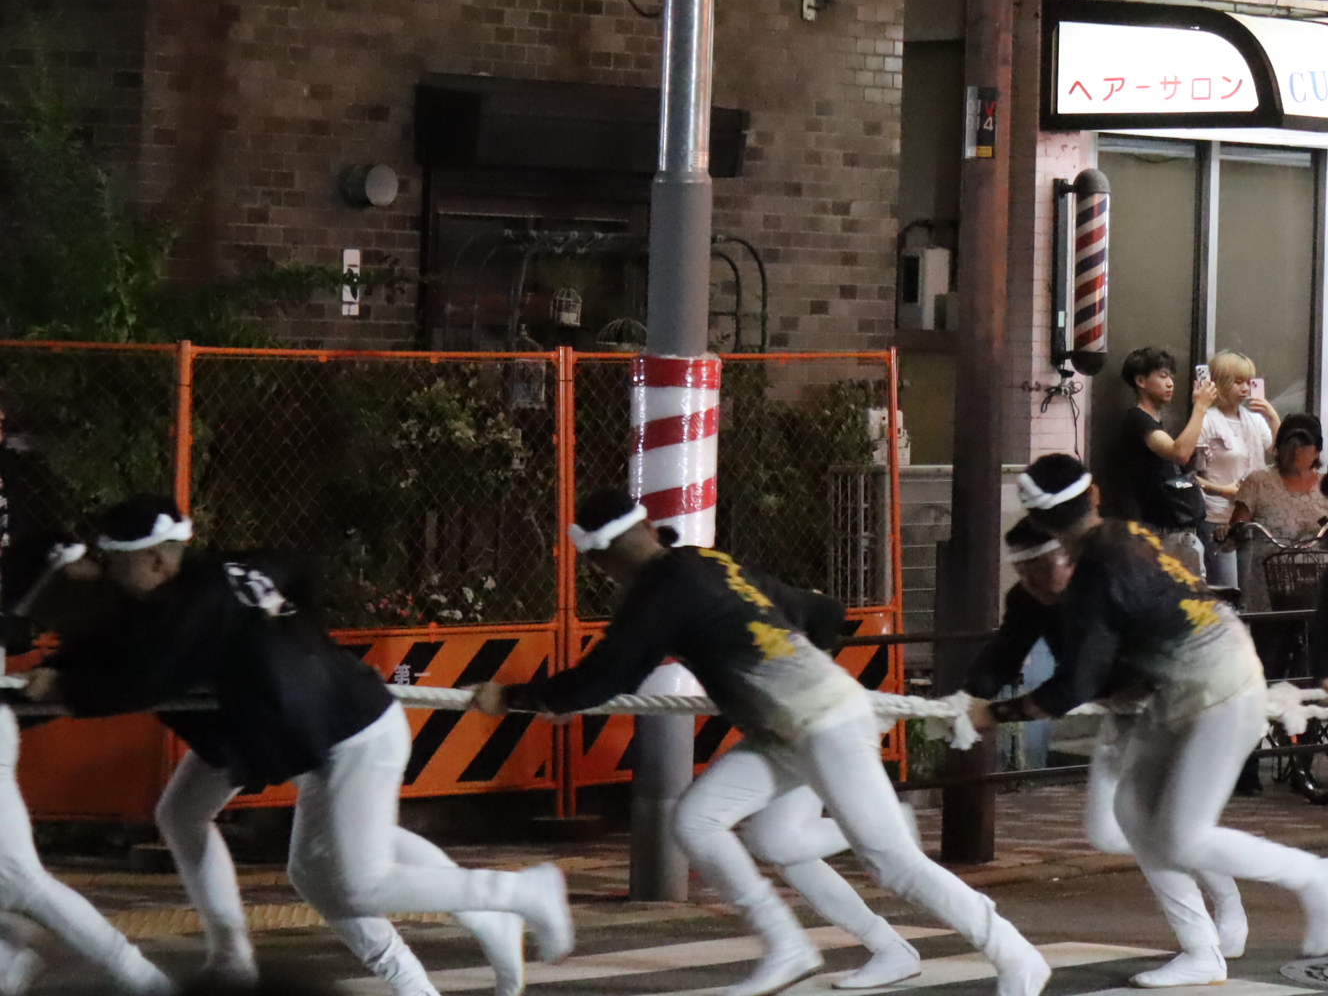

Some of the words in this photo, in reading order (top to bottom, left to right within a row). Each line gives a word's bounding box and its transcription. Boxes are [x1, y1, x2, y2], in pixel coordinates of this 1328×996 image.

[1067, 74, 1244, 101] ヘアーサロン
